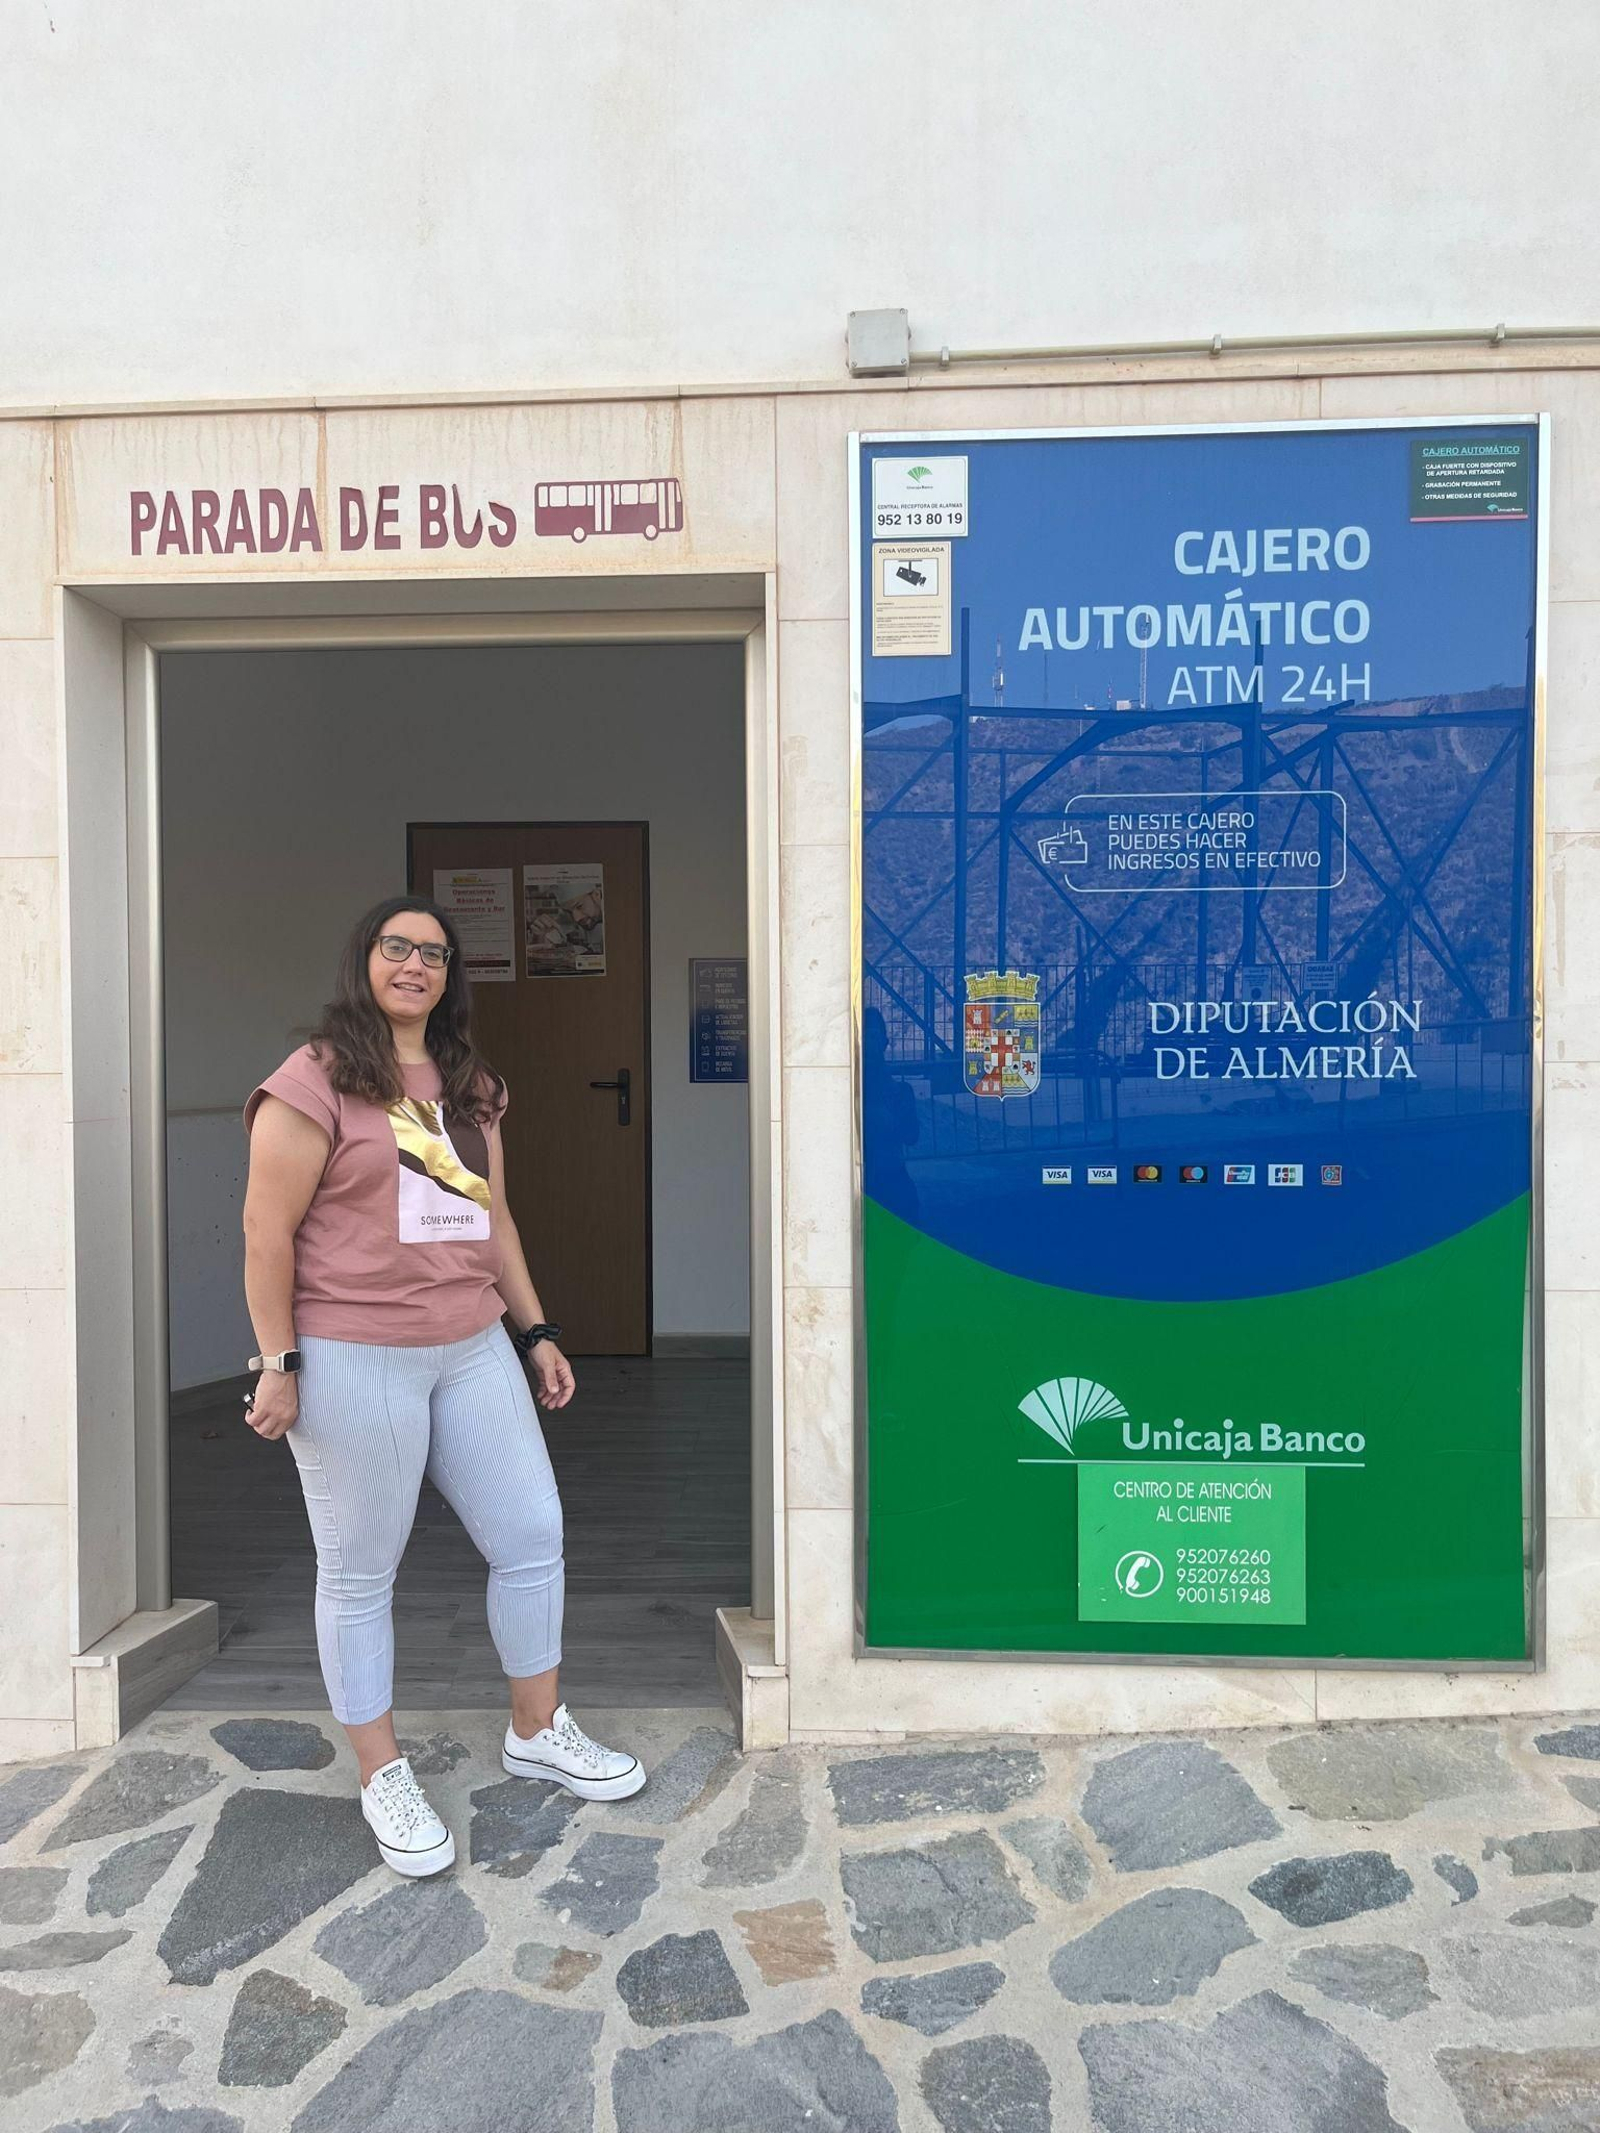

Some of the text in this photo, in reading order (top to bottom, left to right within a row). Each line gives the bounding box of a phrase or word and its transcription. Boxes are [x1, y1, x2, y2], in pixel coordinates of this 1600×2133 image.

[1423, 445, 1520, 455] CAJERO AUTOMÁTICO
[130, 482, 517, 556] PARADA DE BUS
[878, 512, 962, 525] 952 13 80 19
[1174, 526, 1371, 577] CAJERO
[1018, 587, 1370, 651] AUTOMÁTICO
[1167, 662, 1371, 705] ATM 24H
[1108, 811, 1255, 831] EN ESTE CAJERO
[1108, 832, 1247, 850] PUEDES HACER
[1108, 851, 1321, 870] INGRESOS EN EFECTIVO
[1148, 991, 1421, 1035] DIPUTACIÓN
[1153, 1037, 1418, 1081] DE ALMERÍA
[1046, 1171, 1068, 1179] VISA
[1092, 1170, 1112, 1178] VISA
[1275, 1169, 1296, 1181] JCB
[421, 1215, 474, 1225] SOMEWHERE
[1121, 1418, 1366, 1459] Unicaja Banco
[1113, 1478, 1272, 1500] CENTRO DE ATENCIÓN
[1156, 1504, 1232, 1523] AL CLIENTE
[1176, 1549, 1271, 1565] 952076260
[1176, 1568, 1271, 1585] 952076263
[1176, 1587, 1271, 1604] 900151948
